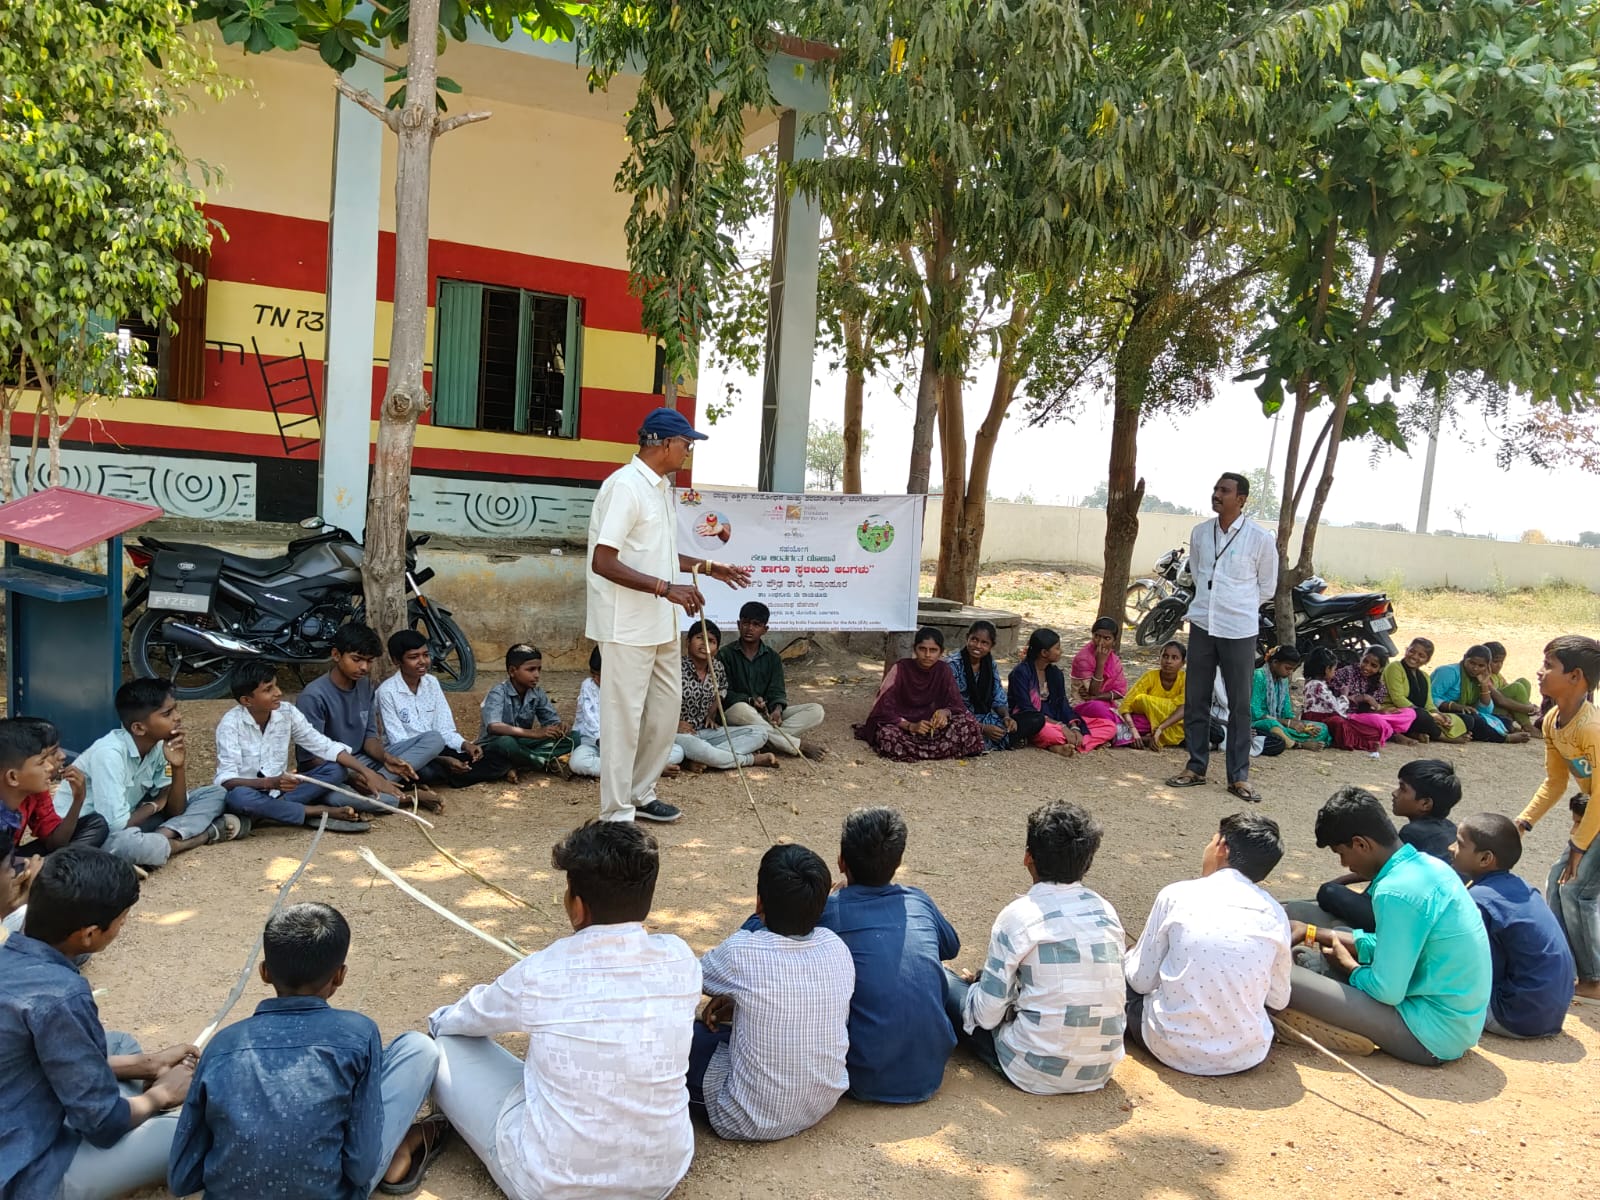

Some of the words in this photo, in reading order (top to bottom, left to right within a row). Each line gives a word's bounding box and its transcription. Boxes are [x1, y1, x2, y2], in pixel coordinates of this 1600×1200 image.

[253, 304, 290, 328] TN
[296, 310, 324, 332] 73
[155, 596, 196, 607] FYZER
